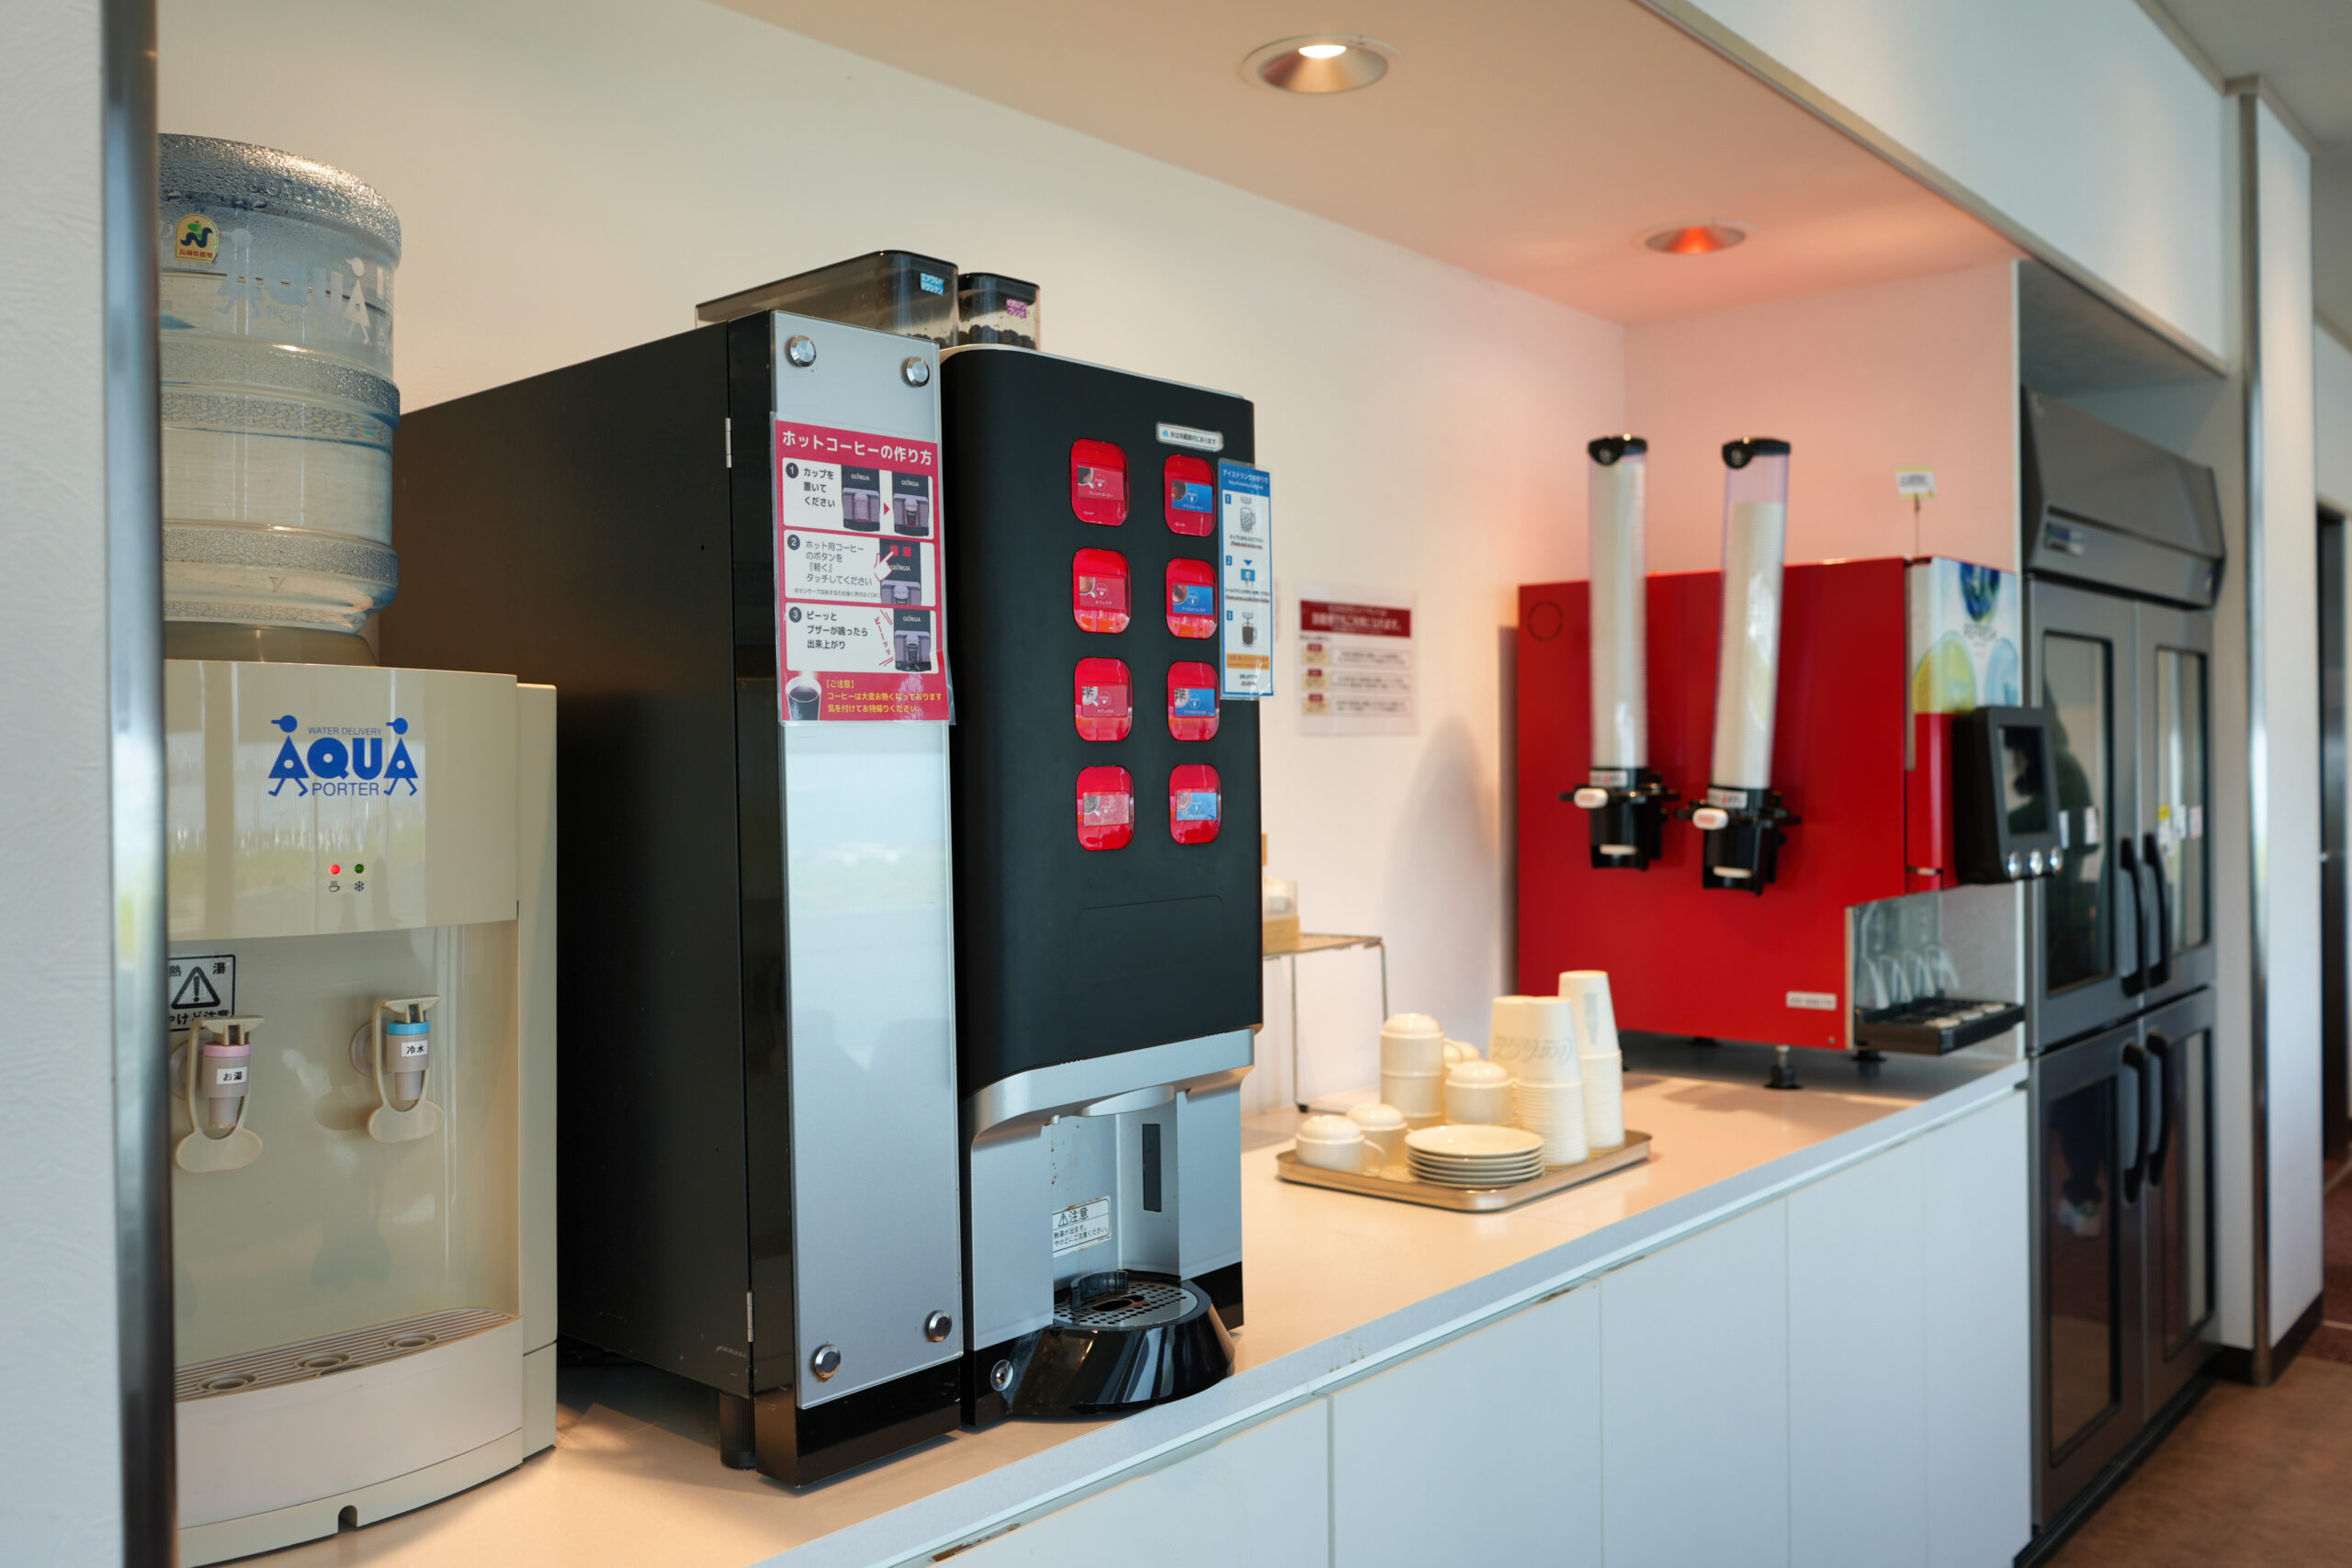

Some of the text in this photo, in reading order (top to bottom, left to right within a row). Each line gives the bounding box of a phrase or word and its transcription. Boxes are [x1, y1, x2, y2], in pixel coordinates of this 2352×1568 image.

[782, 430, 932, 466] ホットコーヒーの作り方
[803, 468, 834, 480] カップを
[803, 481, 827, 493] 置いて
[804, 496, 835, 508] ください
[806, 540, 865, 554] ホット用コーヒー
[806, 551, 843, 563] のボタンを
[807, 573, 873, 586] タッチしてください
[807, 610, 838, 622] ピーッと
[807, 625, 868, 637] ブザーが鳴ったら
[807, 639, 846, 650] 出来上がり
[308, 727, 382, 736] WATER DELIVERY
[268, 724, 419, 795] AQUA
[311, 782, 379, 796] PORTER
[406, 1044, 425, 1055] 冷水
[222, 1071, 243, 1082] お湯
[1069, 1207, 1089, 1224] 注意
